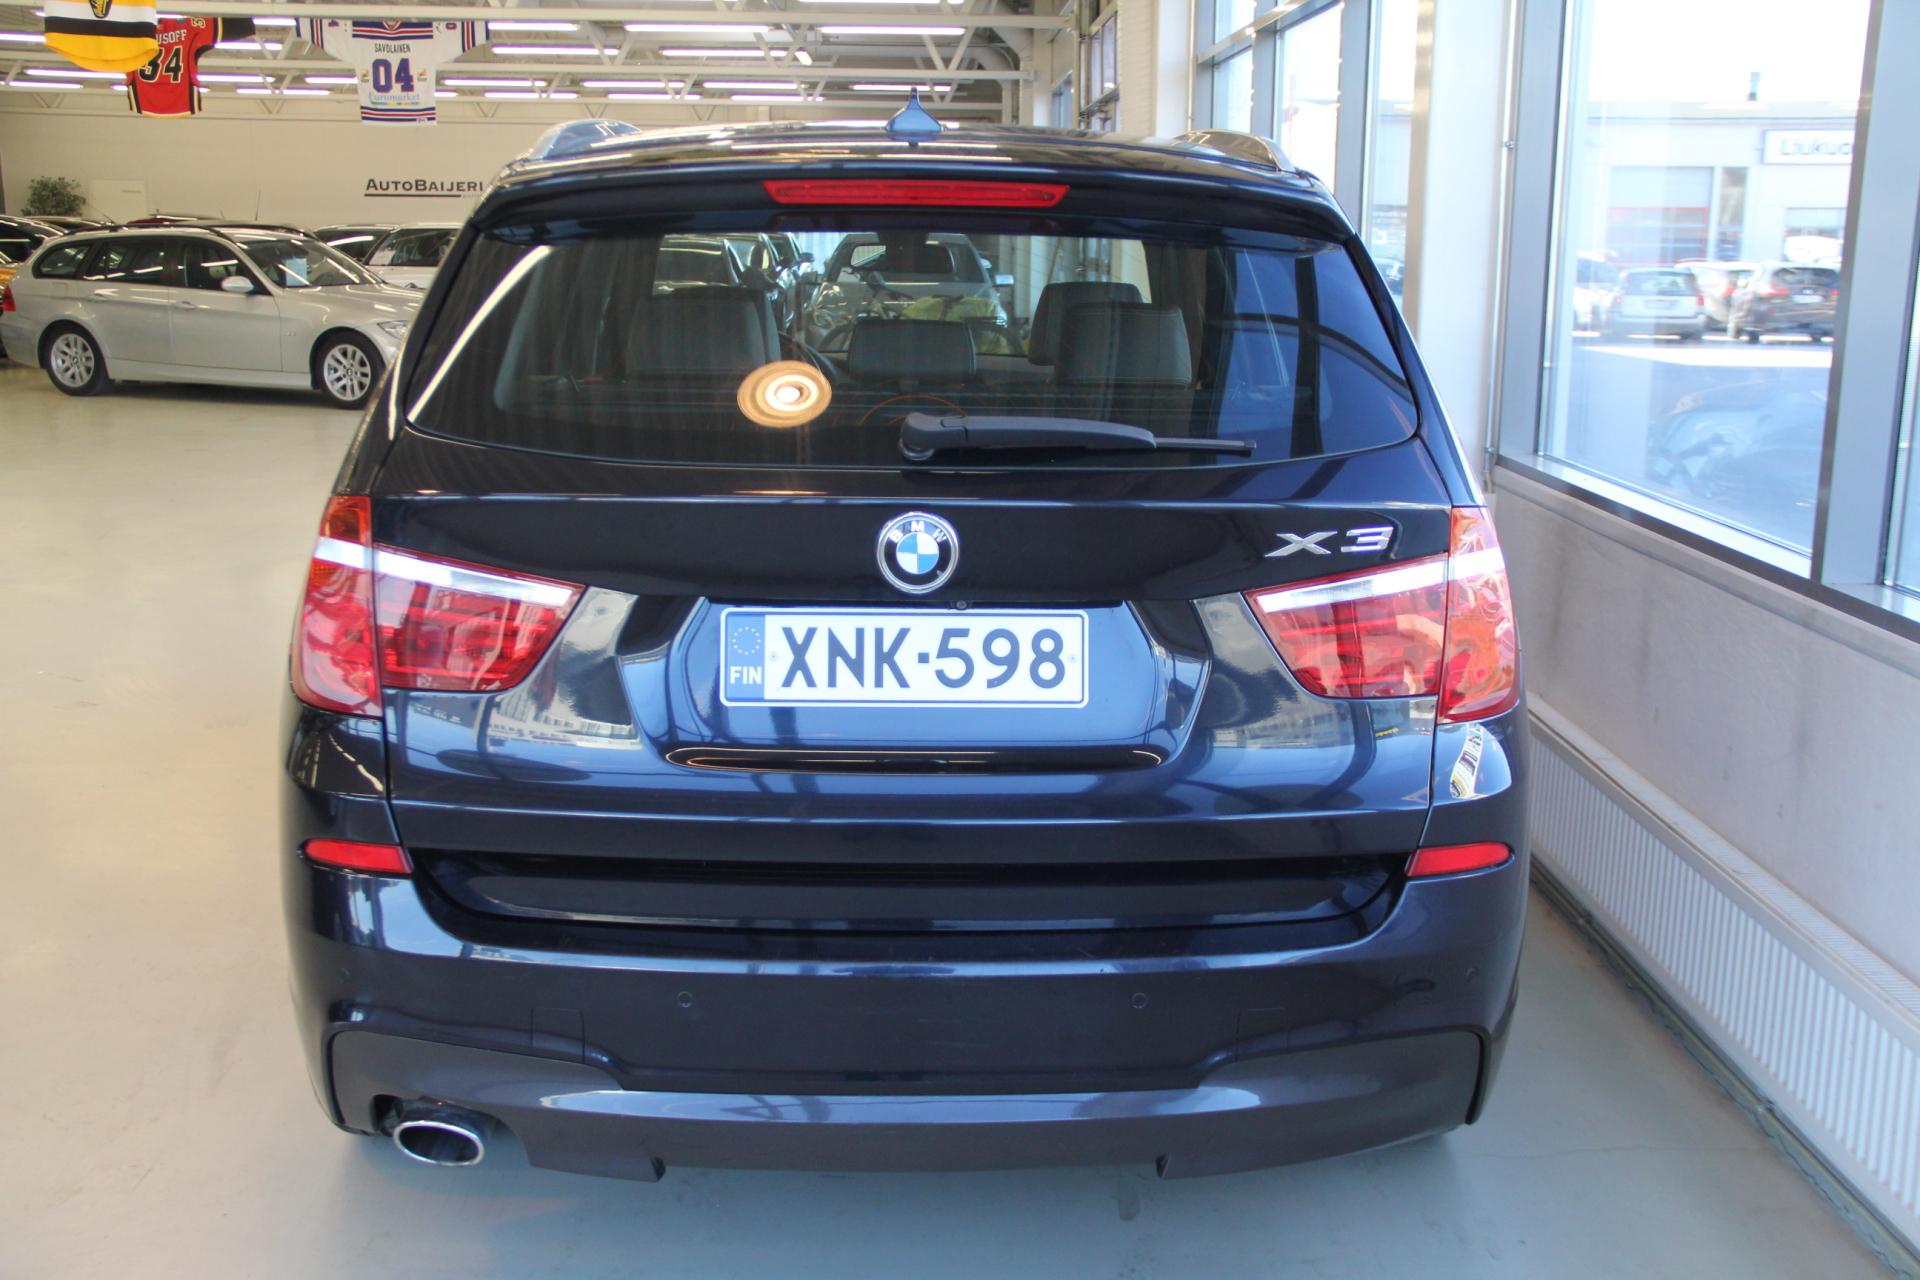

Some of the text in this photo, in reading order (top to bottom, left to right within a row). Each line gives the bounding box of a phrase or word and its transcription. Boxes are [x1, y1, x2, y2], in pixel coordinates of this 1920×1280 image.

[374, 43, 411, 53] SAVOLAINEN
[138, 45, 184, 83] 34
[372, 57, 415, 93] 04
[888, 520, 949, 544] BMW
[1264, 526, 1394, 557] X3
[730, 666, 761, 685] FIN
